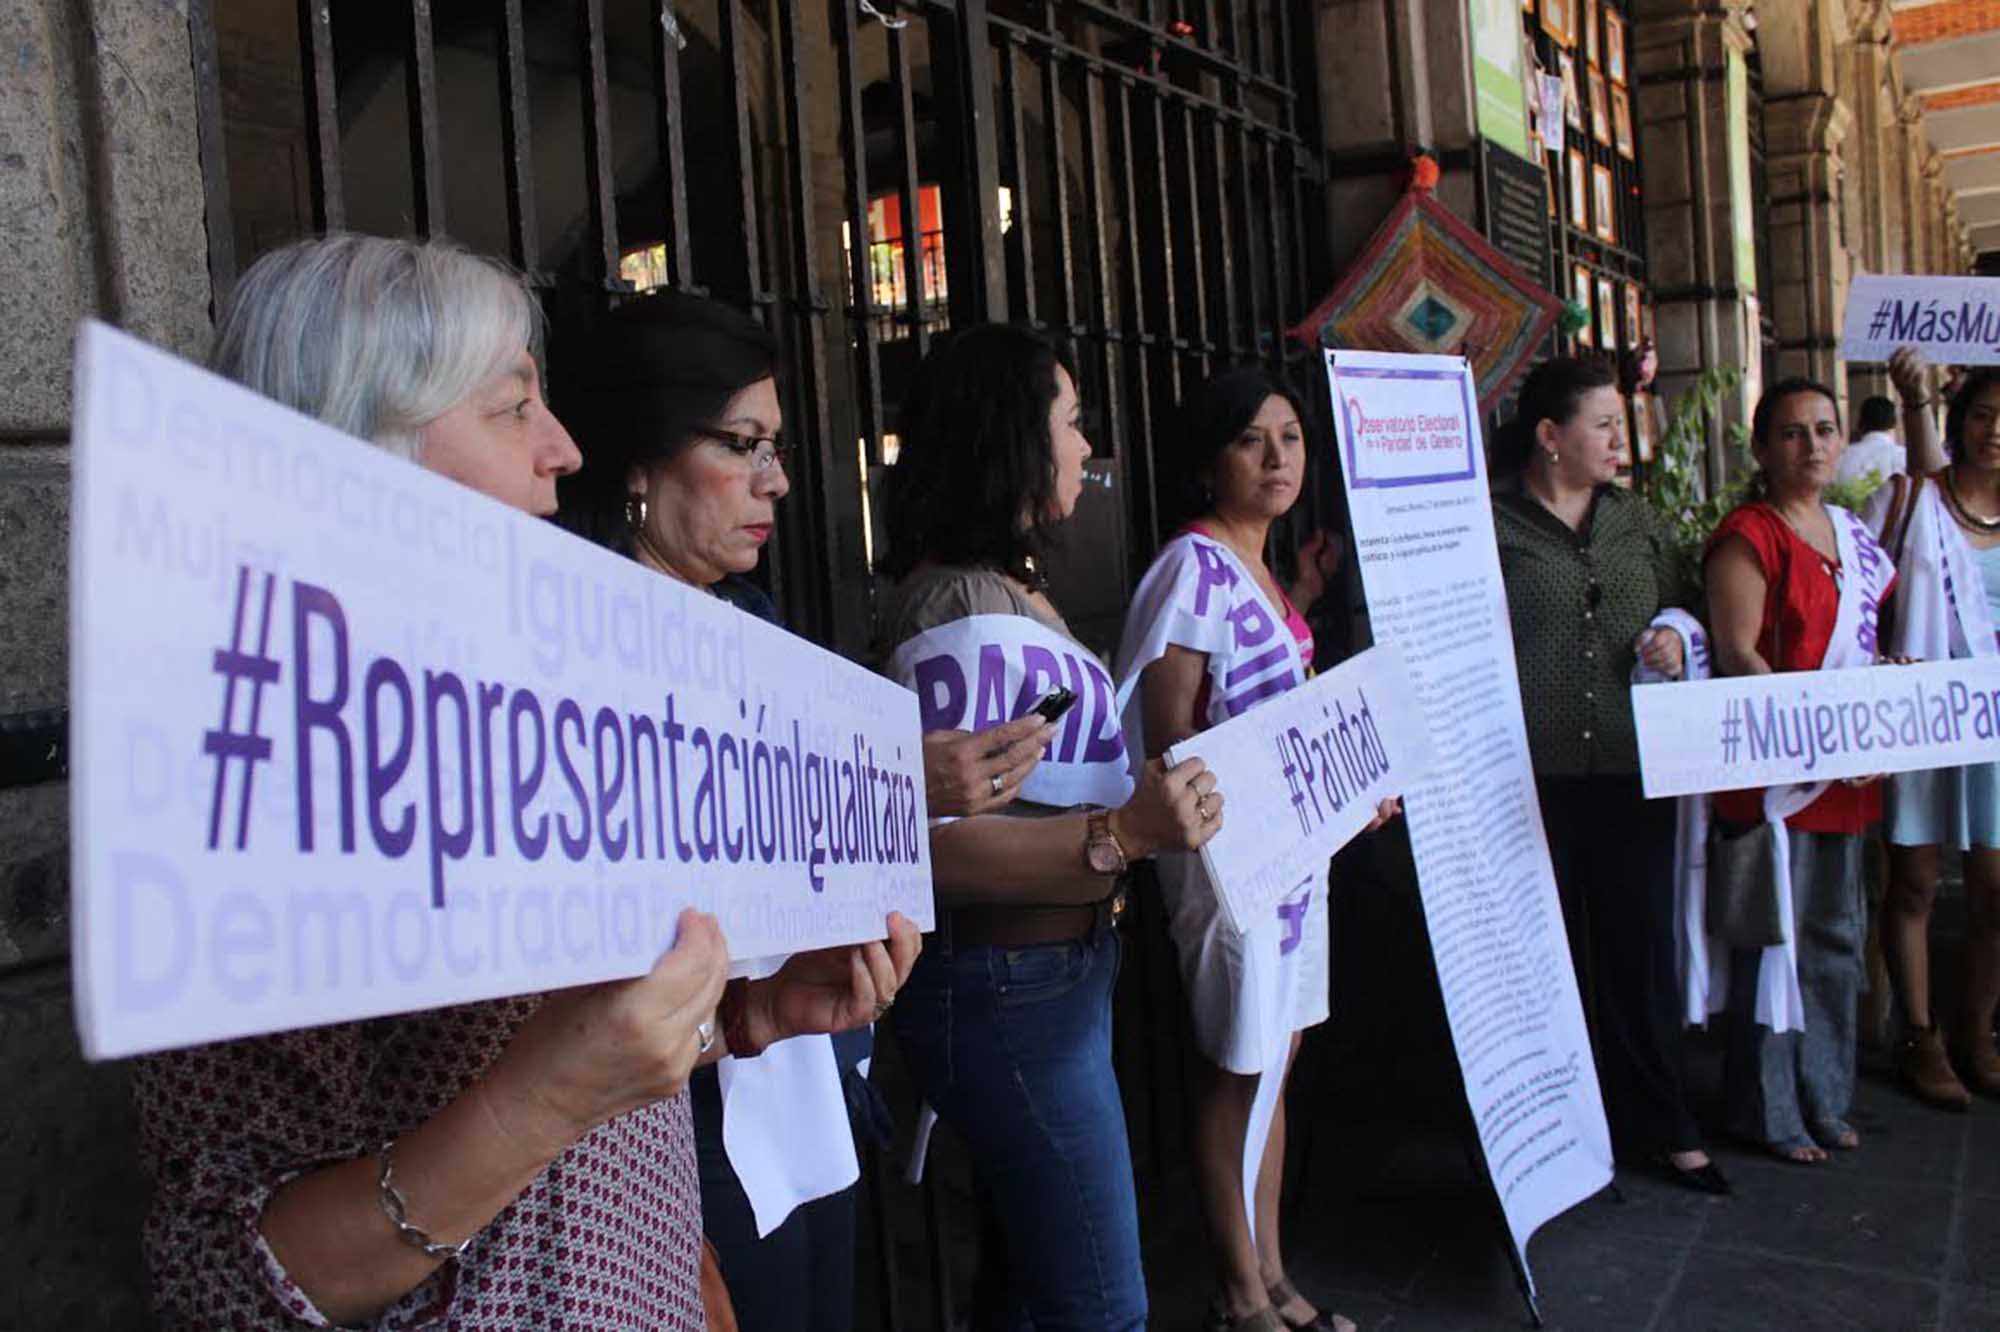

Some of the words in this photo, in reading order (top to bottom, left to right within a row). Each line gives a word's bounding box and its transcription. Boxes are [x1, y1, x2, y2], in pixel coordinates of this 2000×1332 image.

[1868, 298, 2000, 353] #MásMu
[203, 565, 920, 909] #RepresentaciónIgualitaria
[1276, 686, 1390, 837] #Paridad
[111, 848, 642, 1016] Democracia
